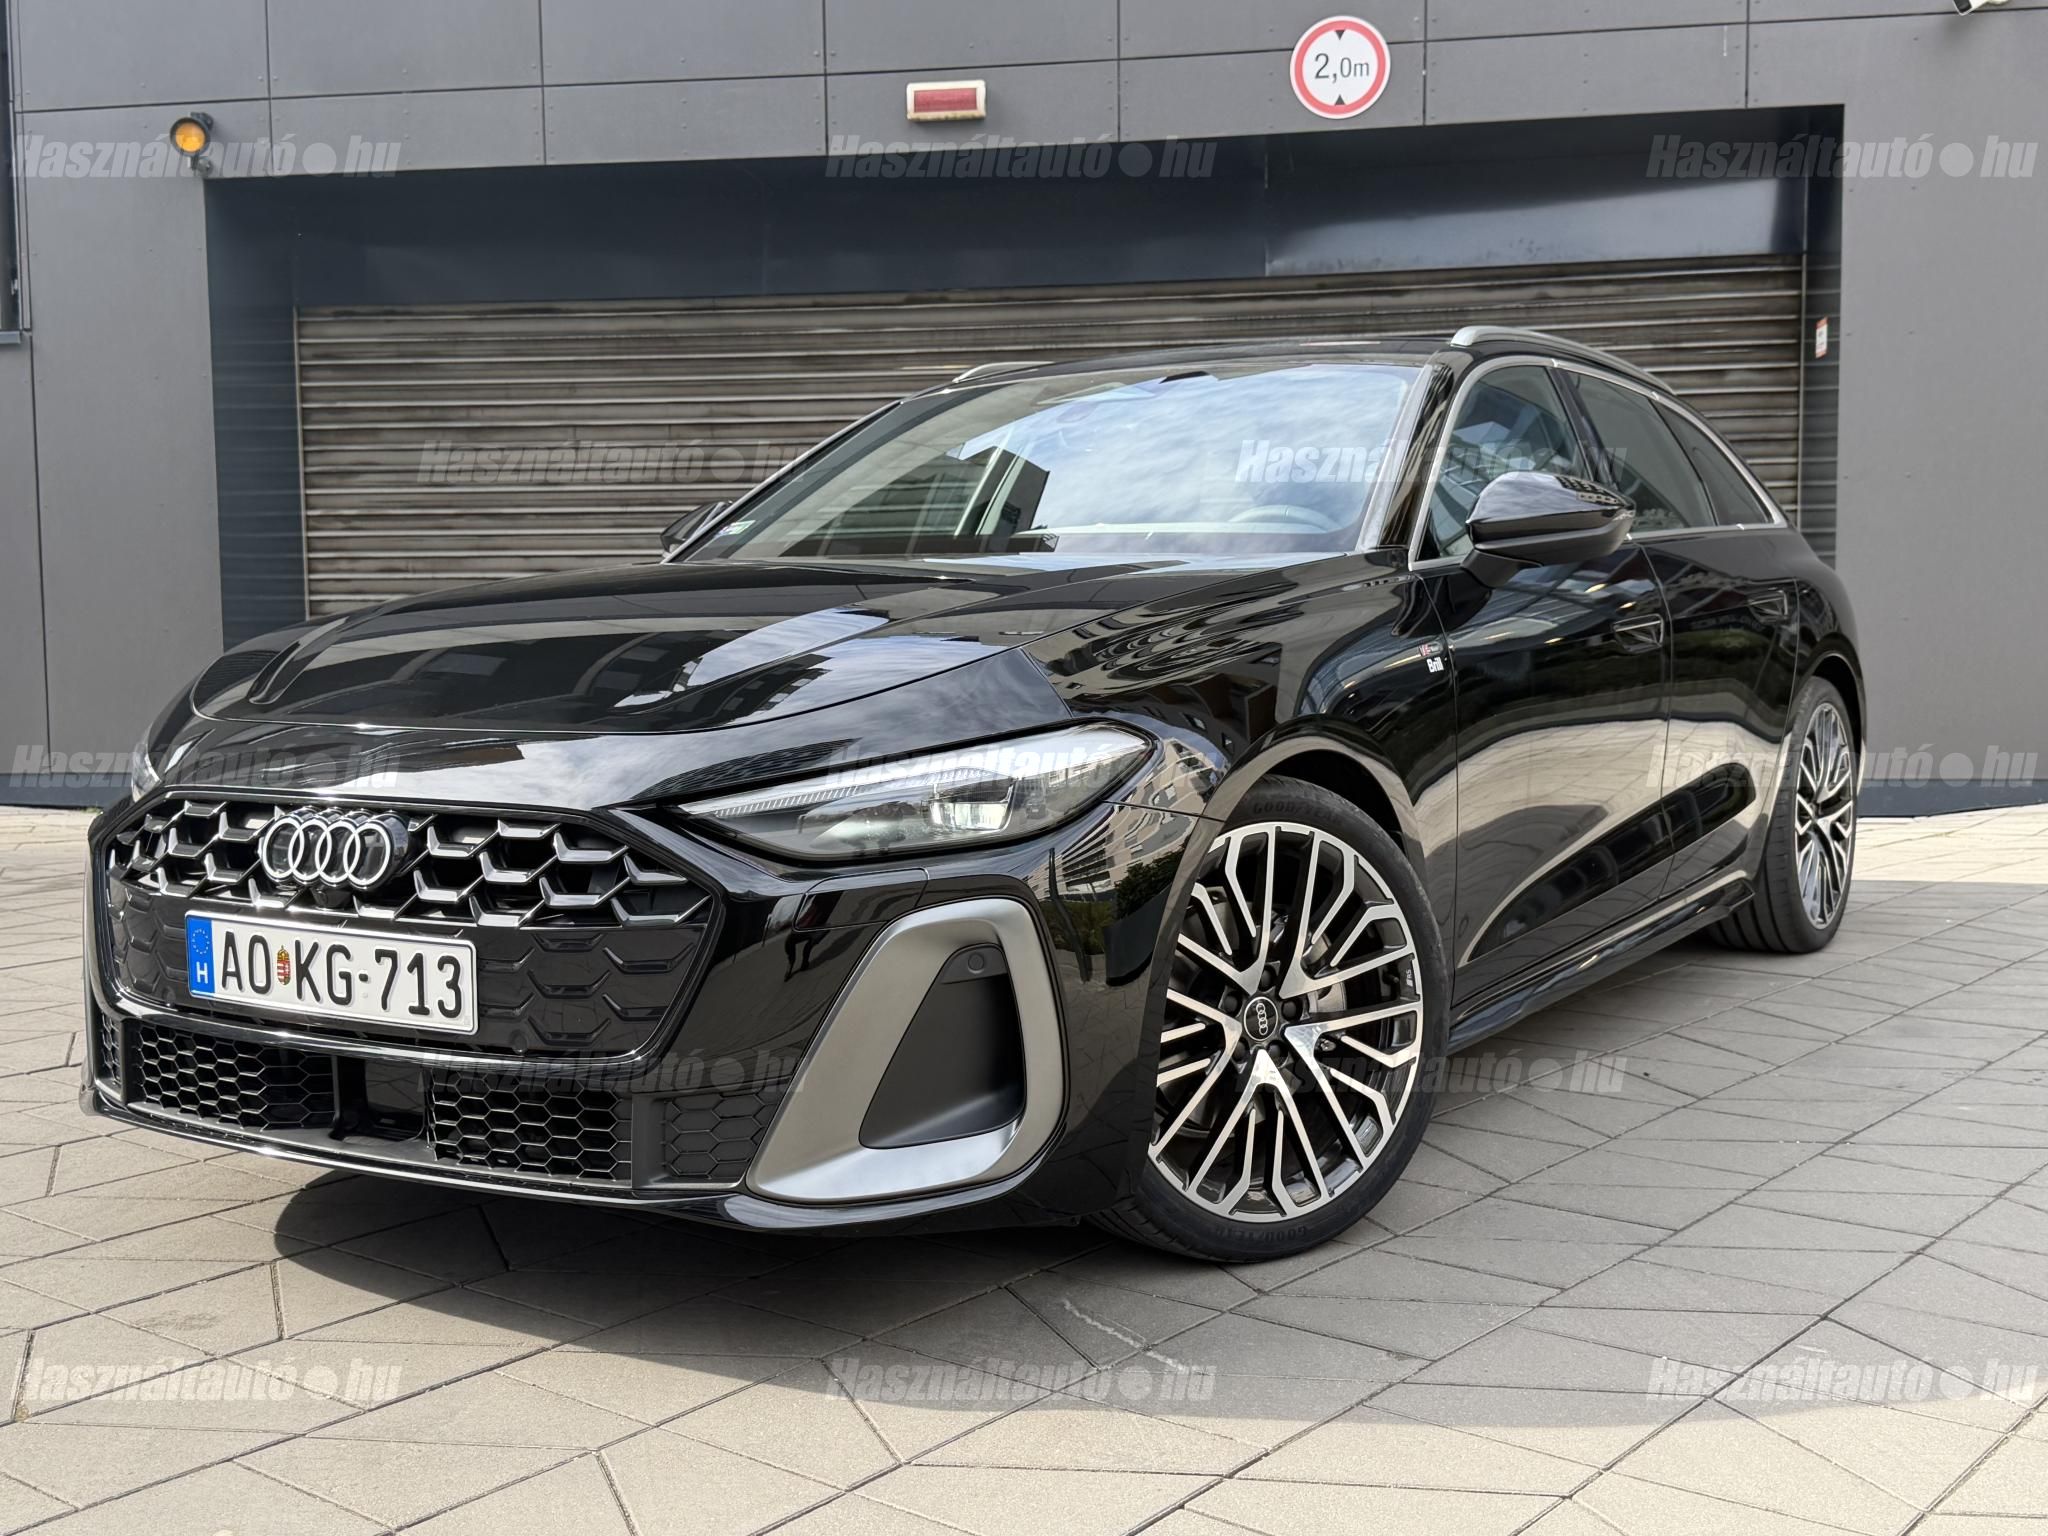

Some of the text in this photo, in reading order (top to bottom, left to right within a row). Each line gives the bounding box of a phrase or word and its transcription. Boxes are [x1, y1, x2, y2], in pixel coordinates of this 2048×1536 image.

[1315, 53, 1369, 84] 2,0m
[196, 961, 209, 984] H
[221, 930, 462, 1019] AO KG-713
